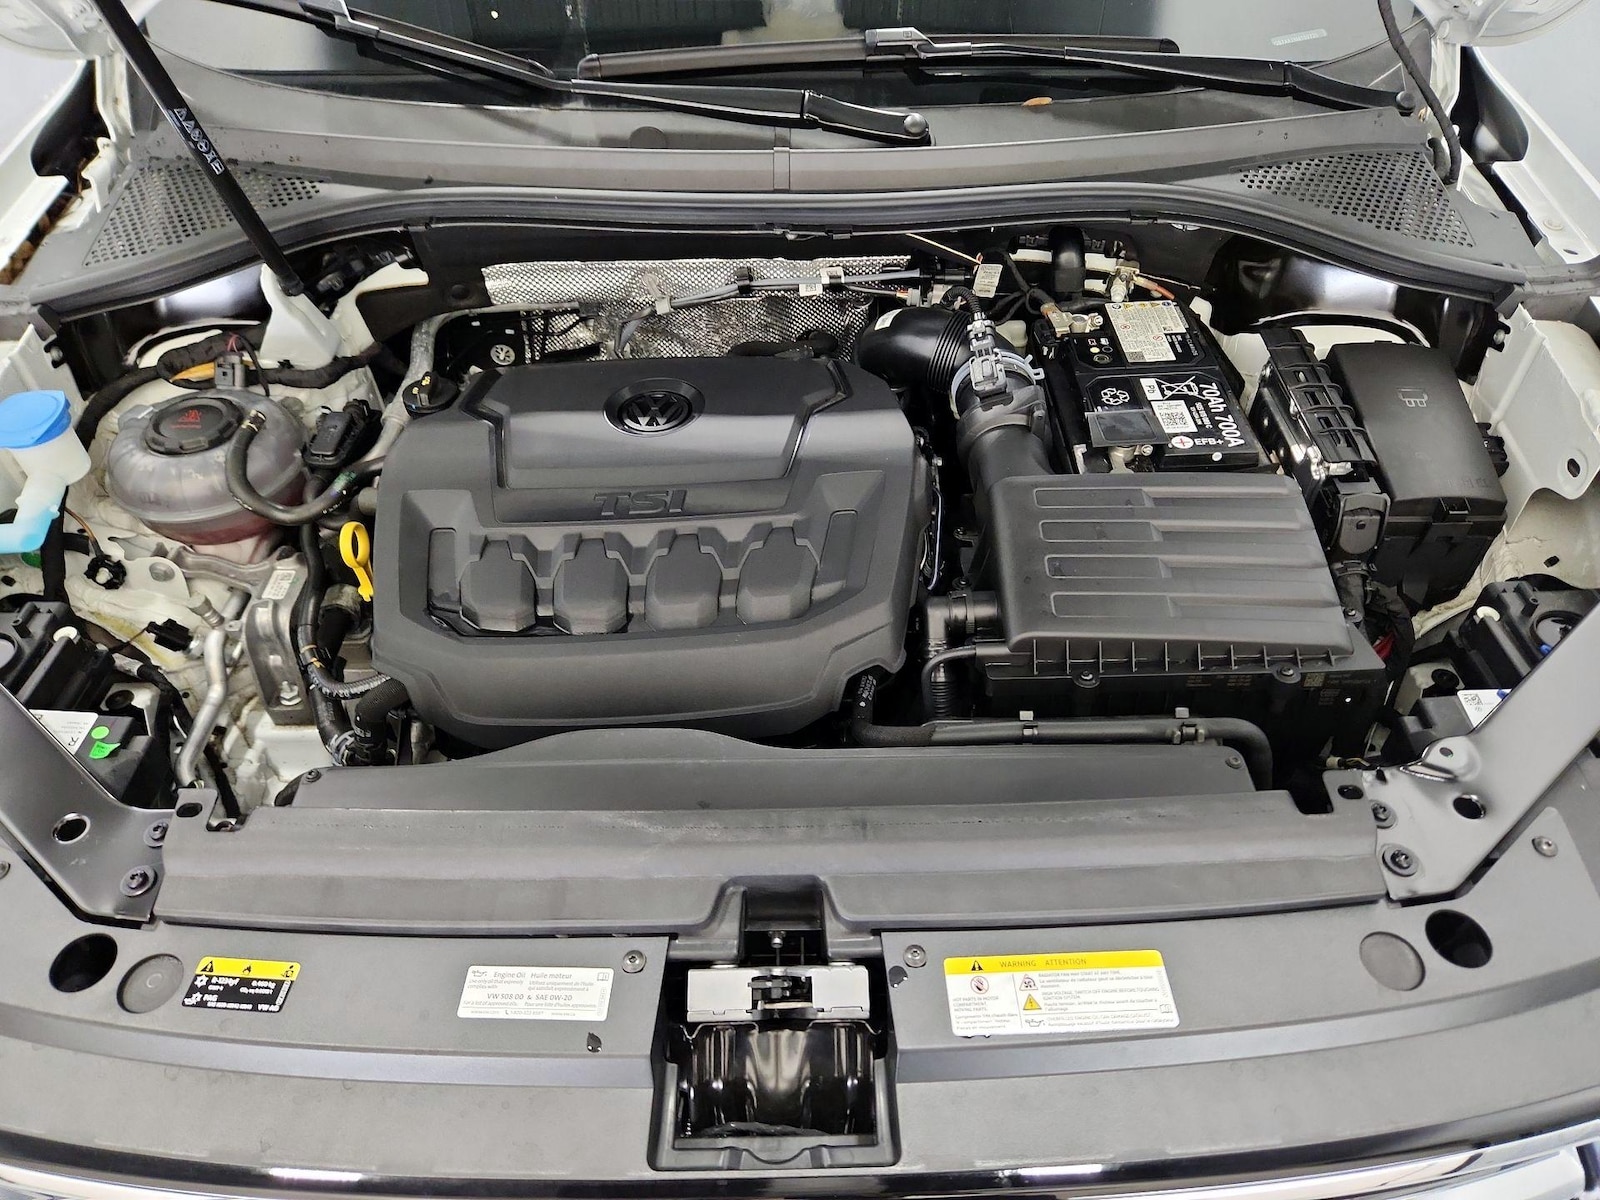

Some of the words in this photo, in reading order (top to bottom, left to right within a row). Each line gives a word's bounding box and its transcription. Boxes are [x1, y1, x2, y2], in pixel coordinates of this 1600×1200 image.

[1145, 384, 1155, 393] Pb
[1199, 382, 1227, 412] 70Ah
[1215, 414, 1245, 447] 700A
[594, 490, 687, 515] TSI
